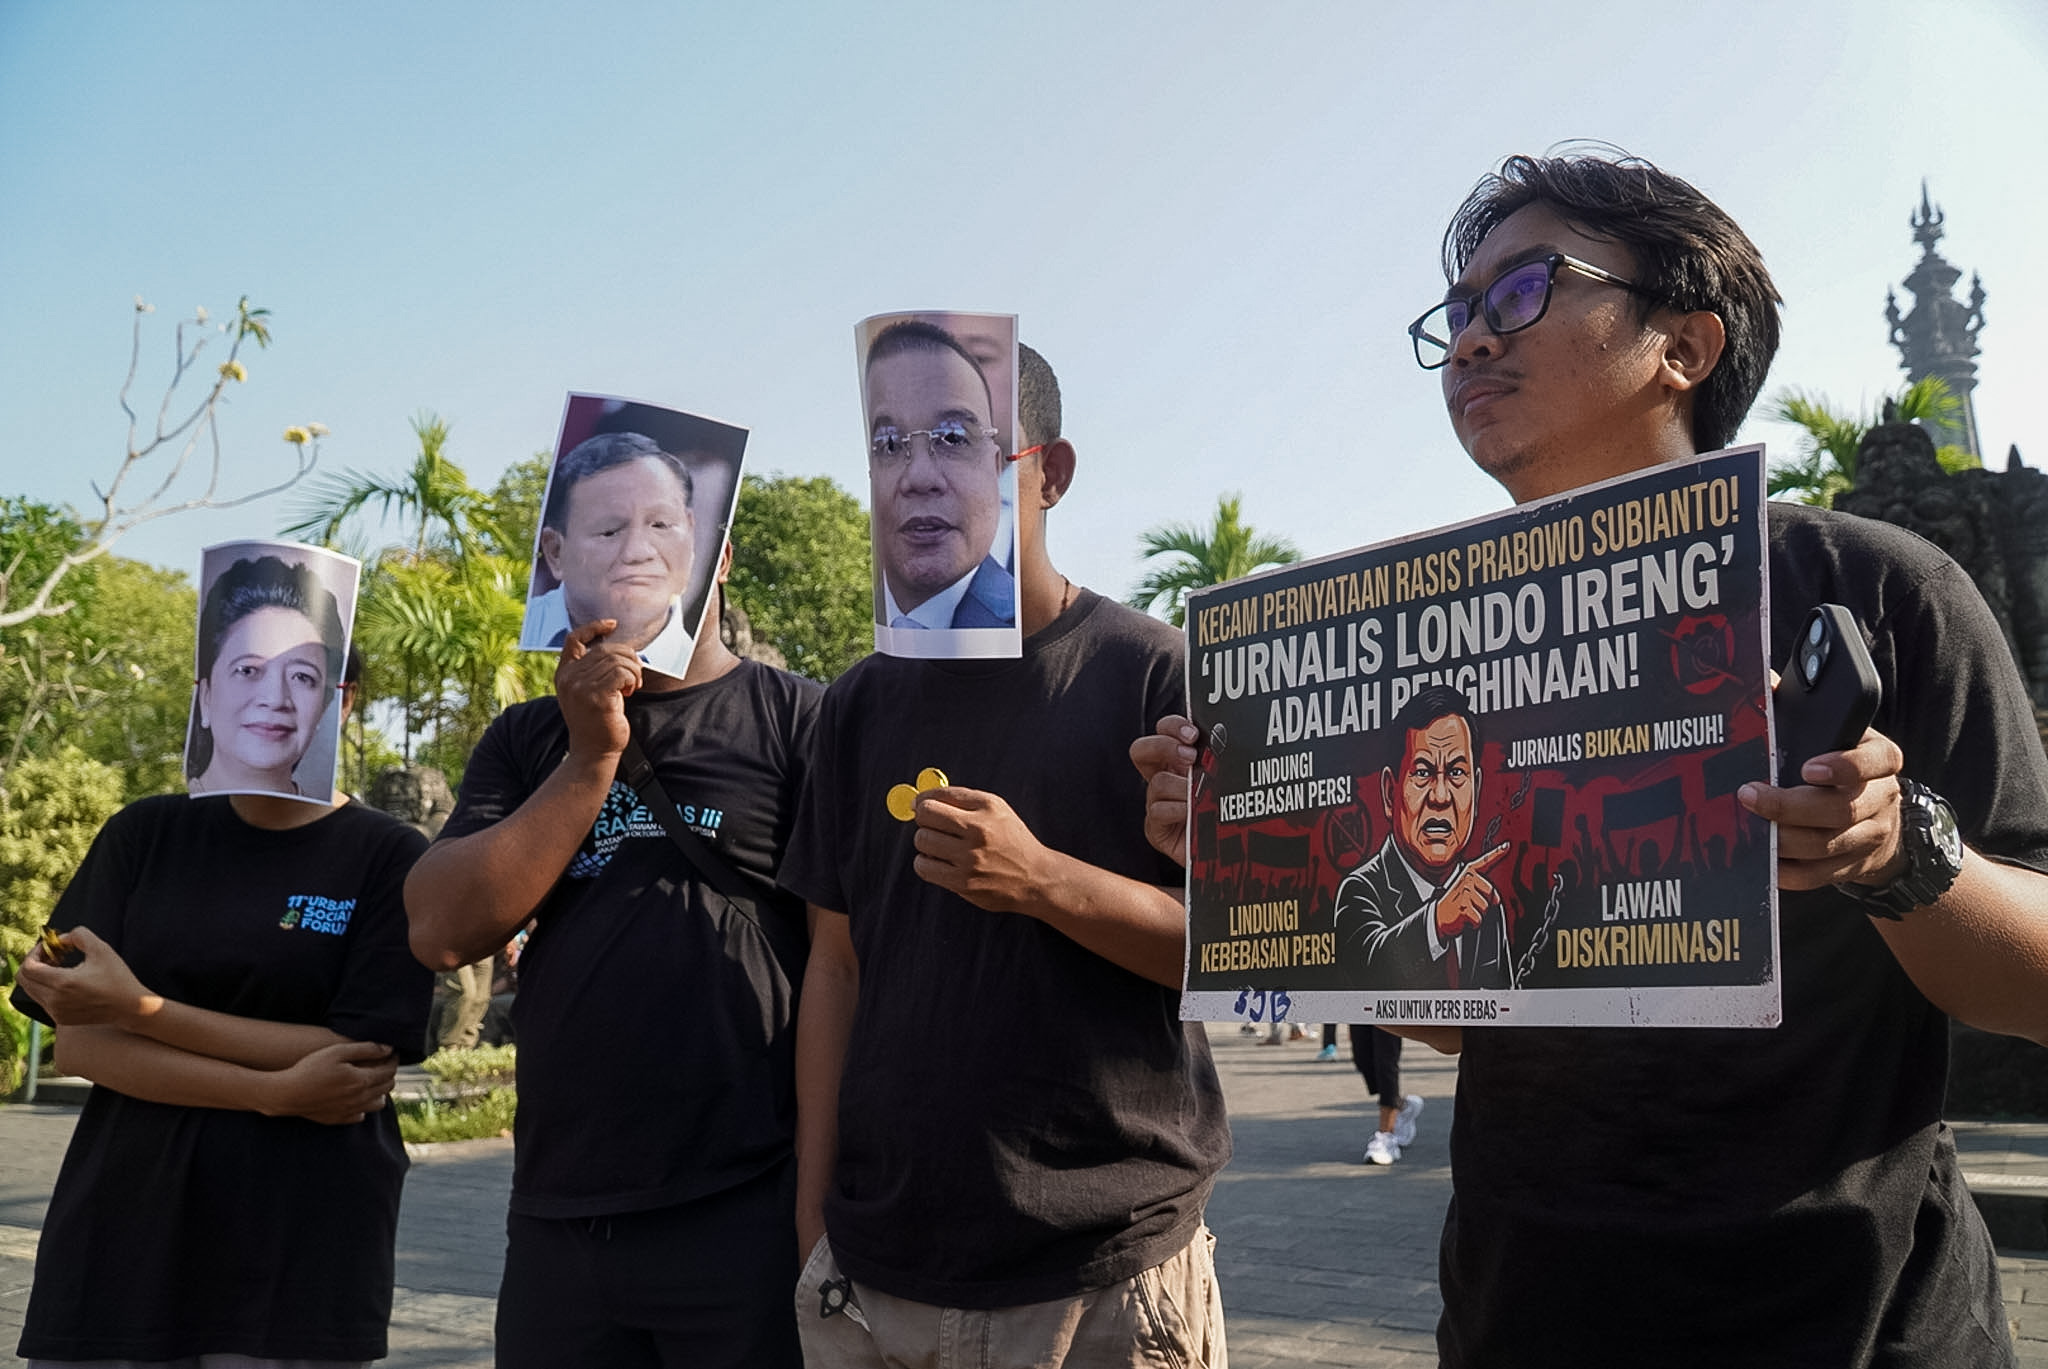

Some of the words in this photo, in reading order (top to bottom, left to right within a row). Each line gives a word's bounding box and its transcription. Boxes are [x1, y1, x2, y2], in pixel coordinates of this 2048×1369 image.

[1198, 593, 1258, 647] KECAM
[1262, 566, 1390, 631] PERNYATAAN
[1395, 550, 1462, 602] RASIS
[1467, 515, 1585, 586] PRABOWO
[1591, 475, 1740, 556] SUBIANTO!
[1396, 582, 1546, 669] LONDO
[1266, 680, 1382, 746] ADALAH
[1507, 732, 1582, 769] JURNALIS
[1585, 724, 1650, 759] BUKAN
[1653, 714, 1725, 749] MUSUH!
[1249, 750, 1314, 788] LINDUNGI
[1219, 784, 1305, 823] KEBEBASAN
[1307, 775, 1352, 809] PERS!
[308, 896, 357, 911] URBAN
[1228, 898, 1299, 937] LINDUNGI
[1600, 878, 1683, 921] LAWAN
[1200, 936, 1290, 973] KEBEBASAN
[1292, 931, 1337, 968] PERS!
[1556, 918, 1741, 969] DISKRIMINASI!
[1376, 1000, 1398, 1020] AKSI
[1399, 1000, 1433, 1020] UNTUK
[1434, 1000, 1462, 1020] PERS
[1463, 1000, 1497, 1020] BEBAS
